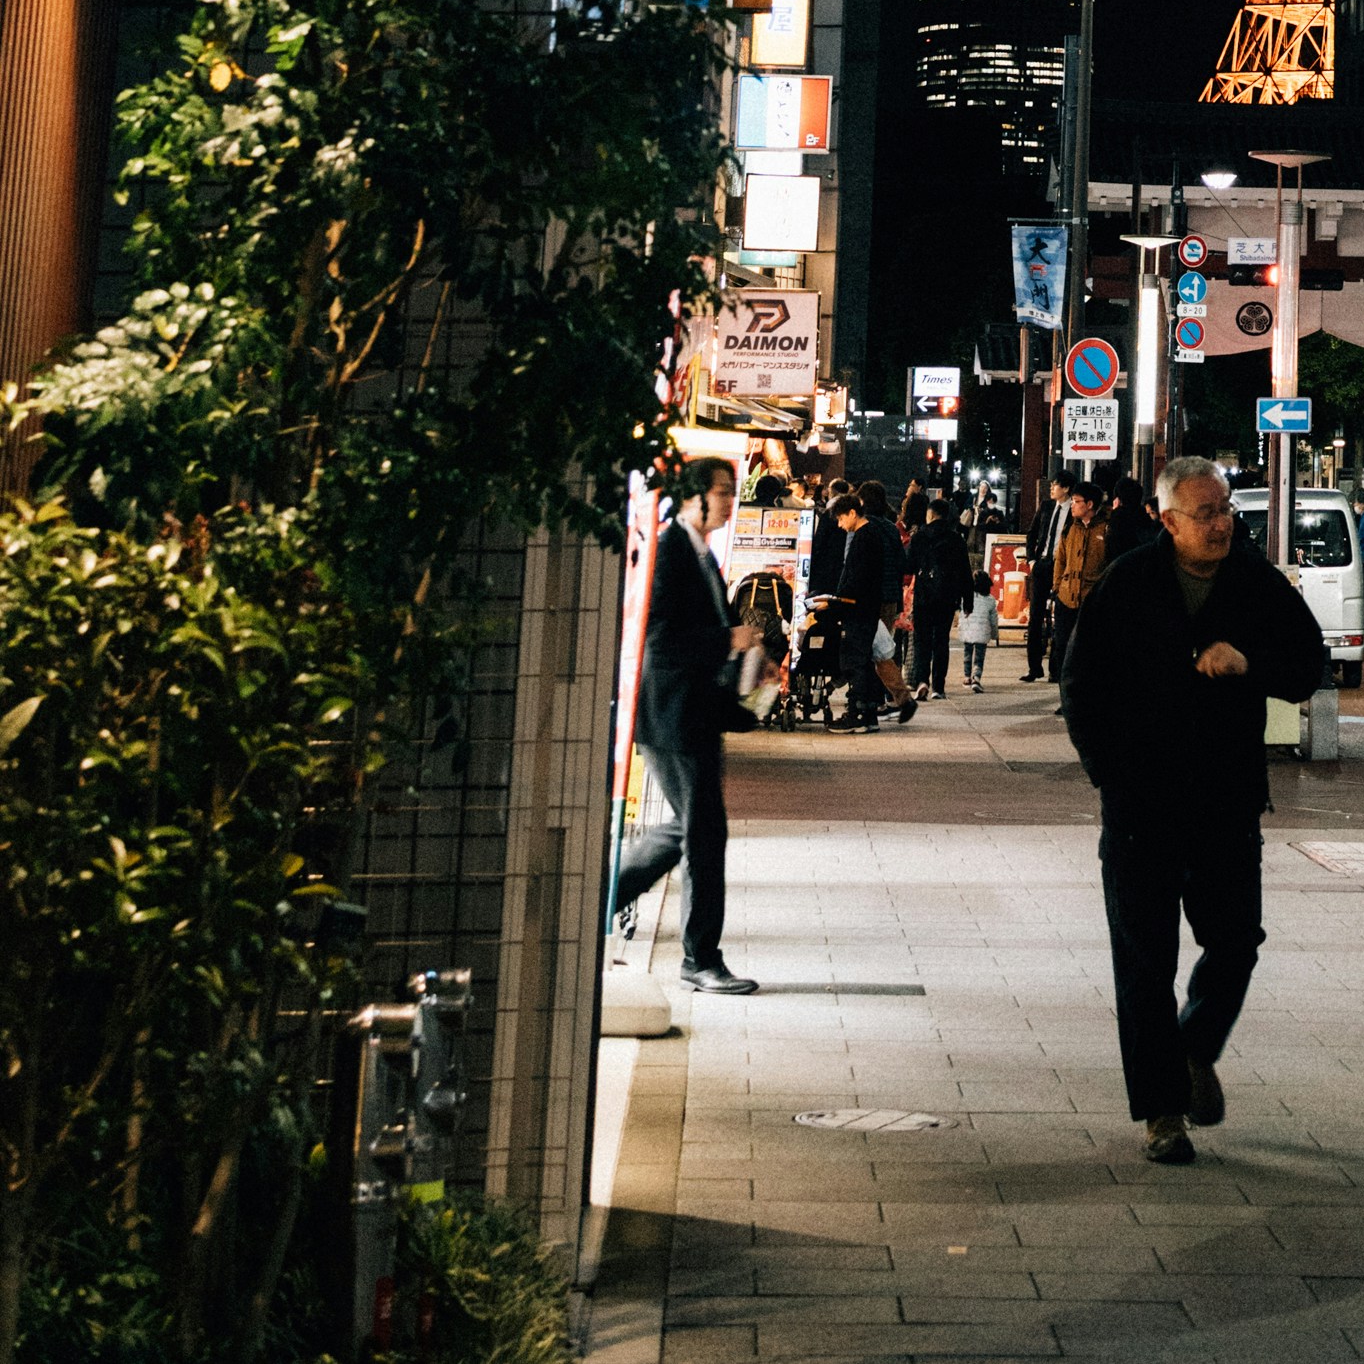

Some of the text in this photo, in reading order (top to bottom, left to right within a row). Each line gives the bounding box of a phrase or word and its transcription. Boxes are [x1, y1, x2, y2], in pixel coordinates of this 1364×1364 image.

[1239, 254, 1277, 262] Shibadaimo
[1182, 306, 1203, 315] 8-20
[724, 335, 809, 351] DAIMON
[720, 361, 810, 370] 大門パフォーマンススタジオ
[922, 374, 953, 384] Times
[716, 379, 738, 393] 5F
[1067, 431, 1114, 442] 貨物を除く
